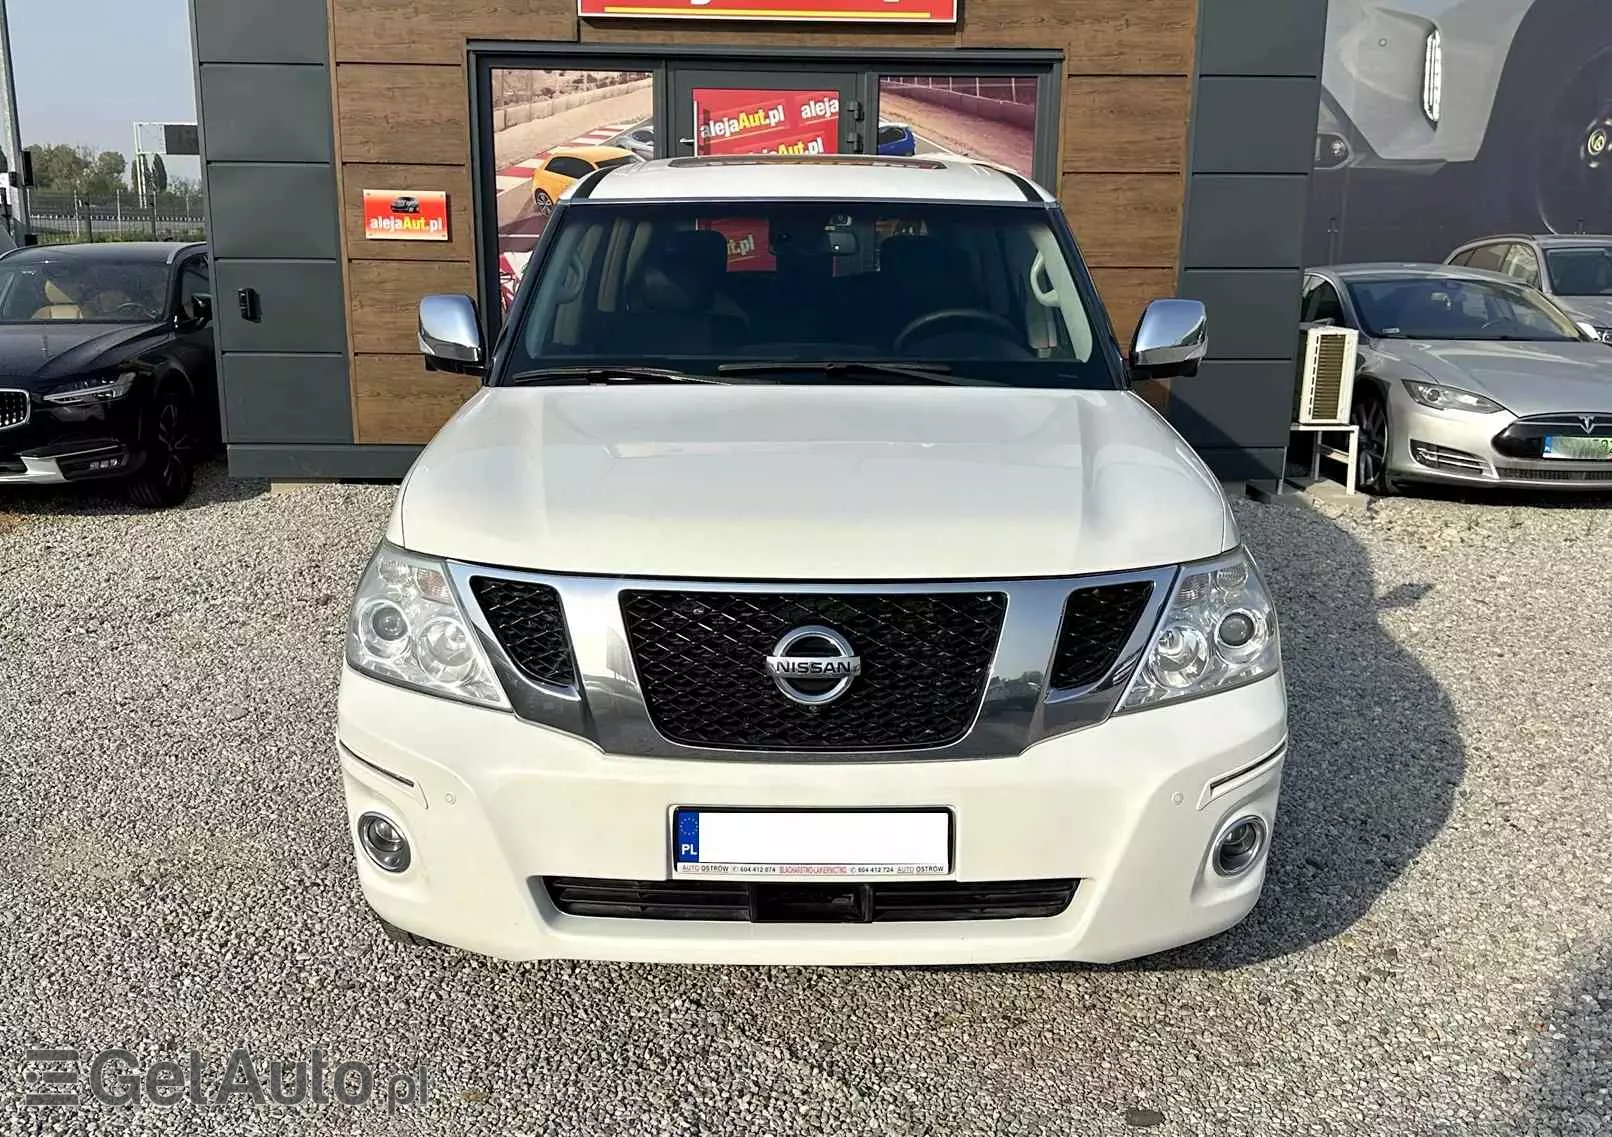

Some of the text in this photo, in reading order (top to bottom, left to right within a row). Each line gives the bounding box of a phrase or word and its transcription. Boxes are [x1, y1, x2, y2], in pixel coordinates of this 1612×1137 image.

[800, 97, 839, 119] aleja
[700, 104, 785, 138] alejaAut.pl
[369, 215, 442, 232] alejaAut.pl
[776, 661, 851, 673] NISSAN
[681, 843, 698, 855] PL
[897, 865, 914, 873] AUTO
